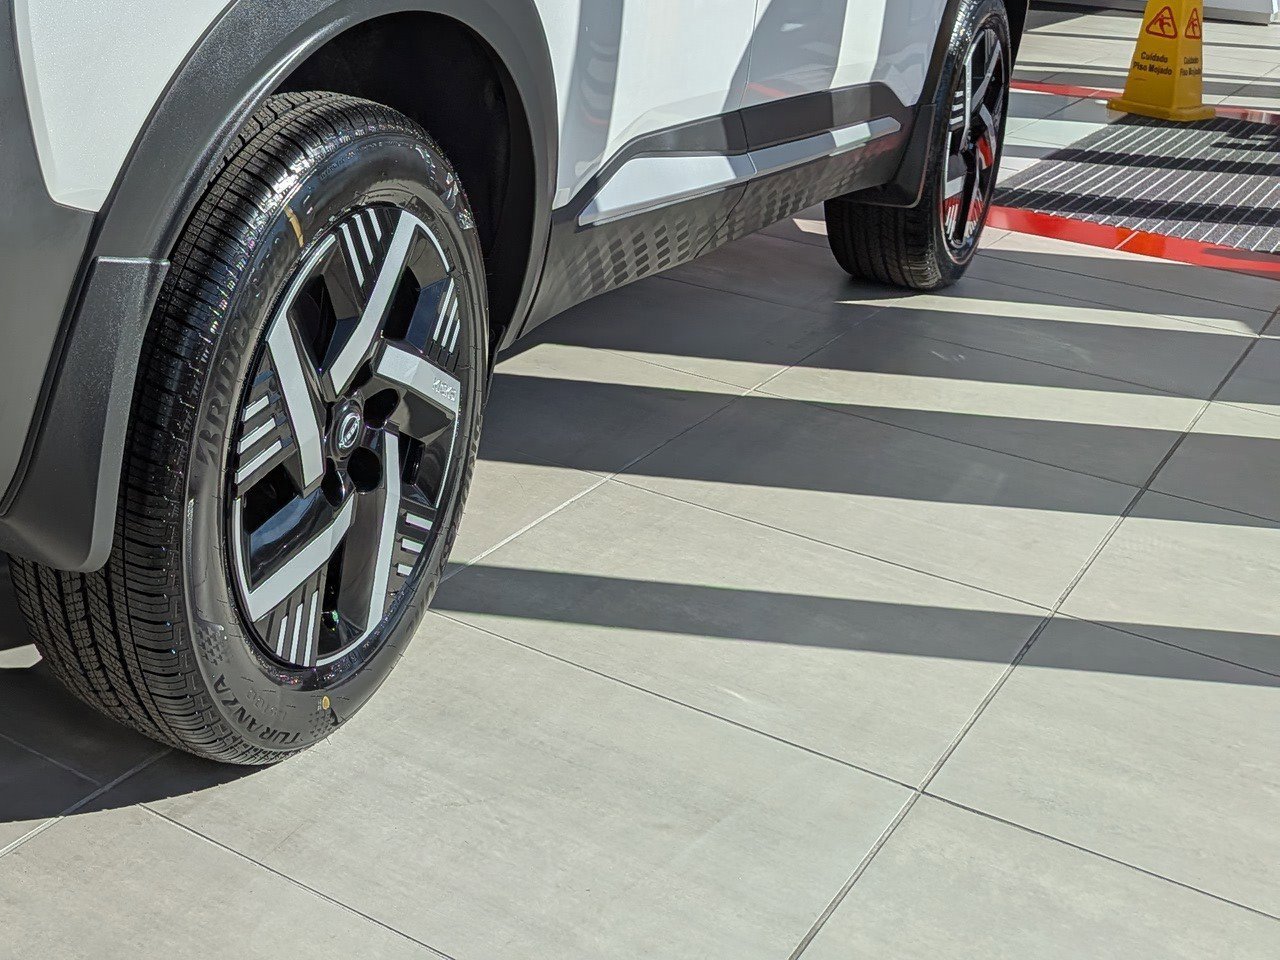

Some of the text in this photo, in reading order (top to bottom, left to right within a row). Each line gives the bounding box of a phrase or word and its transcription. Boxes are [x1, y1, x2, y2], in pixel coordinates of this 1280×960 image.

[1141, 51, 1168, 63] Cuidado
[1133, 61, 1173, 76] Piso Mojado
[212, 673, 301, 745] TURANZA
